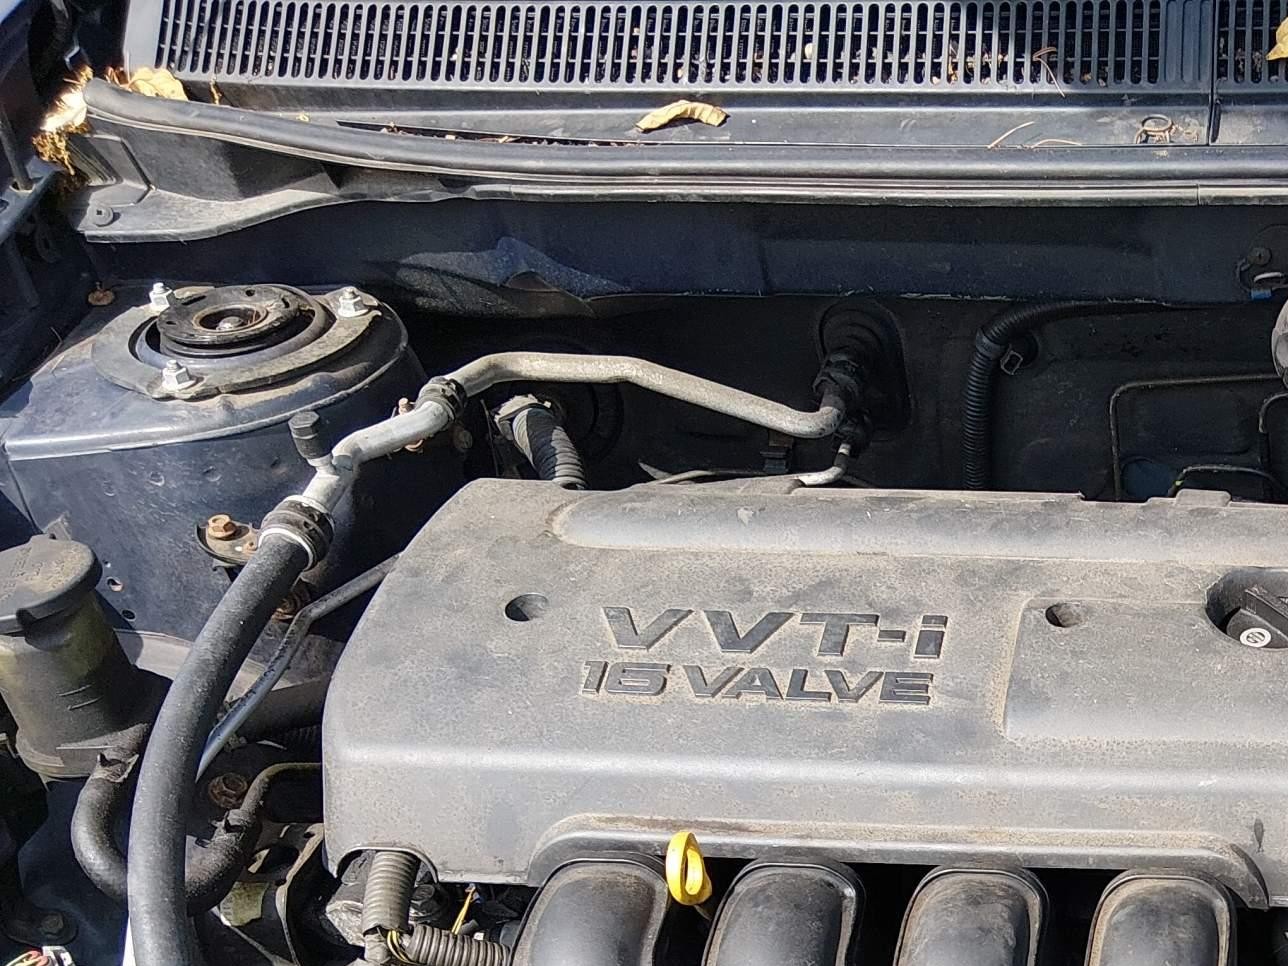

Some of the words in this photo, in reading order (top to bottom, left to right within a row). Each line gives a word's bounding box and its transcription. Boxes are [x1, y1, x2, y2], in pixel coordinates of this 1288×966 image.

[602, 606, 948, 659] VVT-i
[581, 660, 673, 696] 16
[683, 664, 934, 704] VALVE
